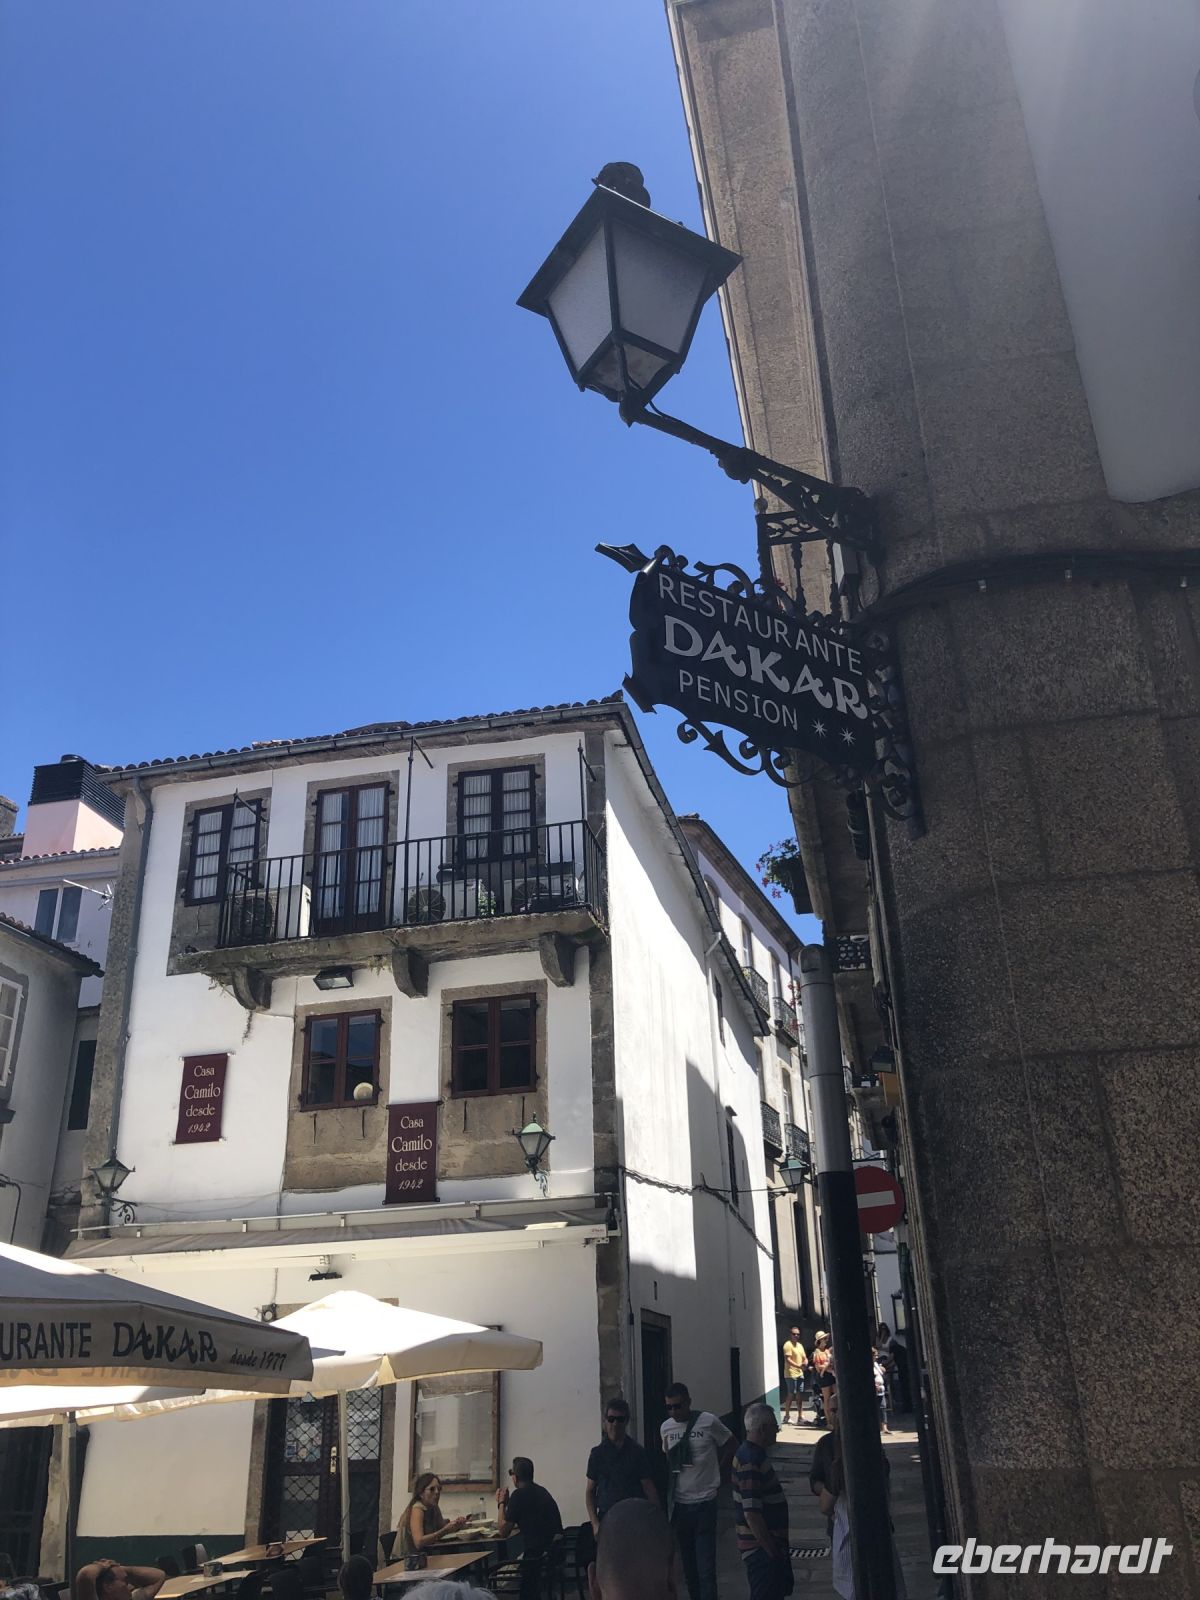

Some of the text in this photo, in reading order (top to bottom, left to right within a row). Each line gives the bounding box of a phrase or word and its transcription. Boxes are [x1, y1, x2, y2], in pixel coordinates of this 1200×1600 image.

[658, 573, 863, 676] RESTAURANTE
[664, 614, 868, 719] DAKAR
[679, 669, 798, 731] PENSION
[193, 1065, 215, 1077] Casa
[184, 1082, 221, 1100] Camilo
[185, 1103, 216, 1117] desde
[187, 1122, 211, 1134] 1942
[400, 1116, 424, 1129] Casa
[391, 1134, 433, 1153] Camilo
[395, 1157, 428, 1172] desde
[398, 1178, 424, 1190] 1942
[0, 1321, 288, 1372] URANTE DAKAR desde 1977
